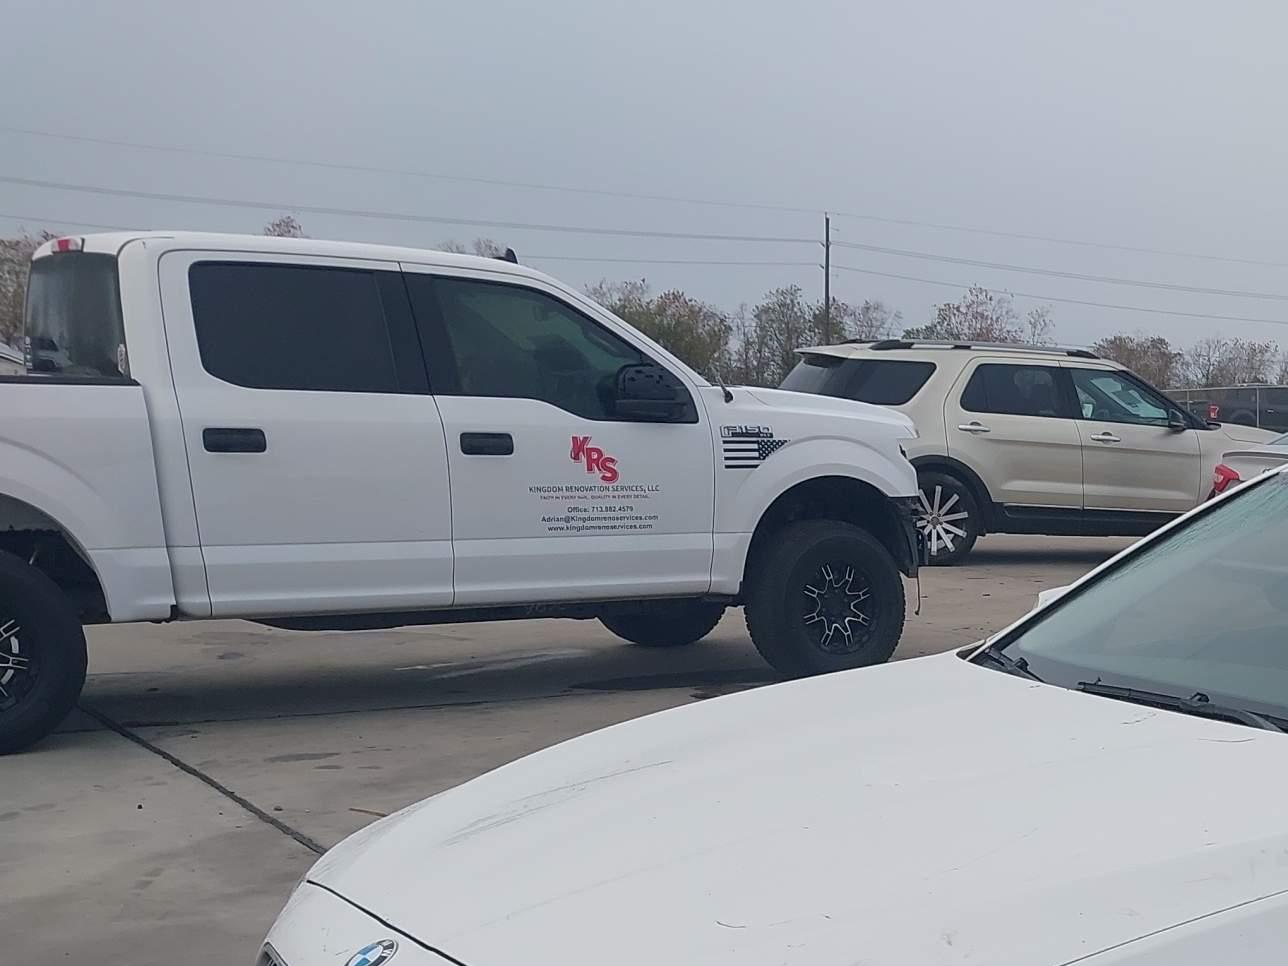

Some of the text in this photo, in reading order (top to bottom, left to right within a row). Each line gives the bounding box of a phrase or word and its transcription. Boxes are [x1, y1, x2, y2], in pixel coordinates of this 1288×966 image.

[569, 434, 619, 484] KRS
[528, 485, 563, 493] KINGDOM
[611, 484, 646, 493] SERVICES,
[647, 484, 660, 492] LLC
